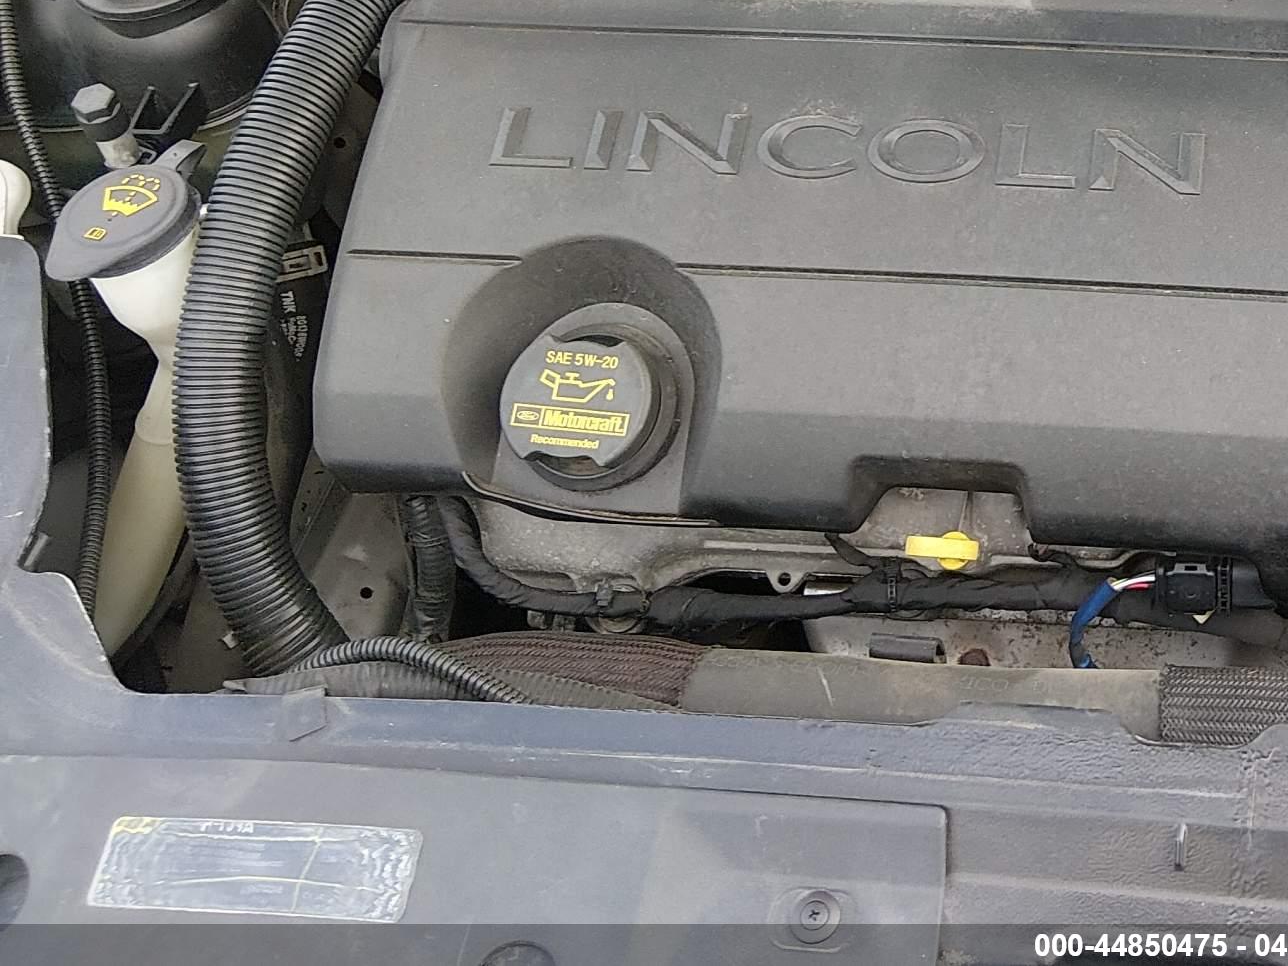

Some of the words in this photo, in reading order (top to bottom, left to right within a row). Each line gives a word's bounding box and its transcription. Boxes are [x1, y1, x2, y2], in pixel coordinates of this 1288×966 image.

[488, 106, 1208, 196] LINCOLN
[280, 290, 297, 313] TNK
[545, 350, 573, 365] SAE
[574, 353, 619, 369] 5W-20
[530, 434, 600, 449] Recommended
